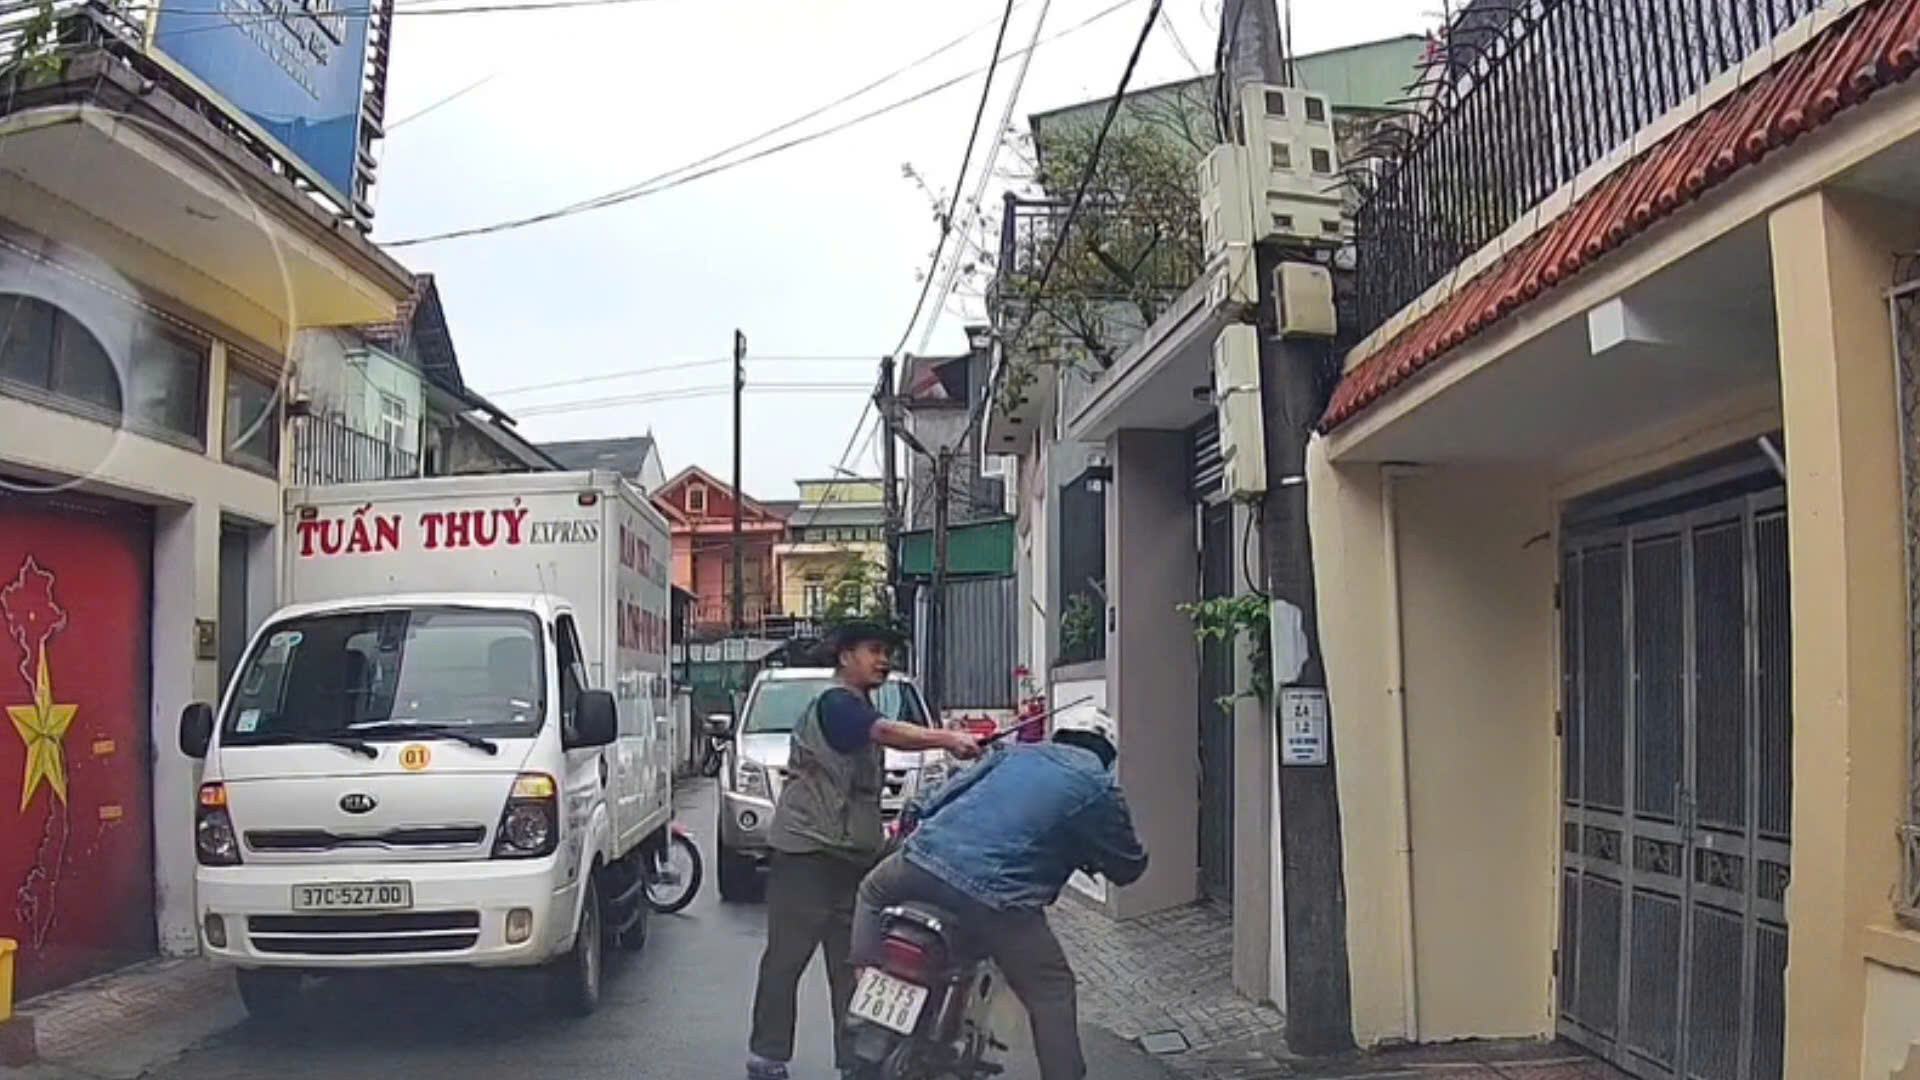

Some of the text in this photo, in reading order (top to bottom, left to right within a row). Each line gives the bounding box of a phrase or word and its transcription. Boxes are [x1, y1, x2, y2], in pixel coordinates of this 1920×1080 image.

[296, 498, 598, 557] TUẤN THUỶ EXPRESS
